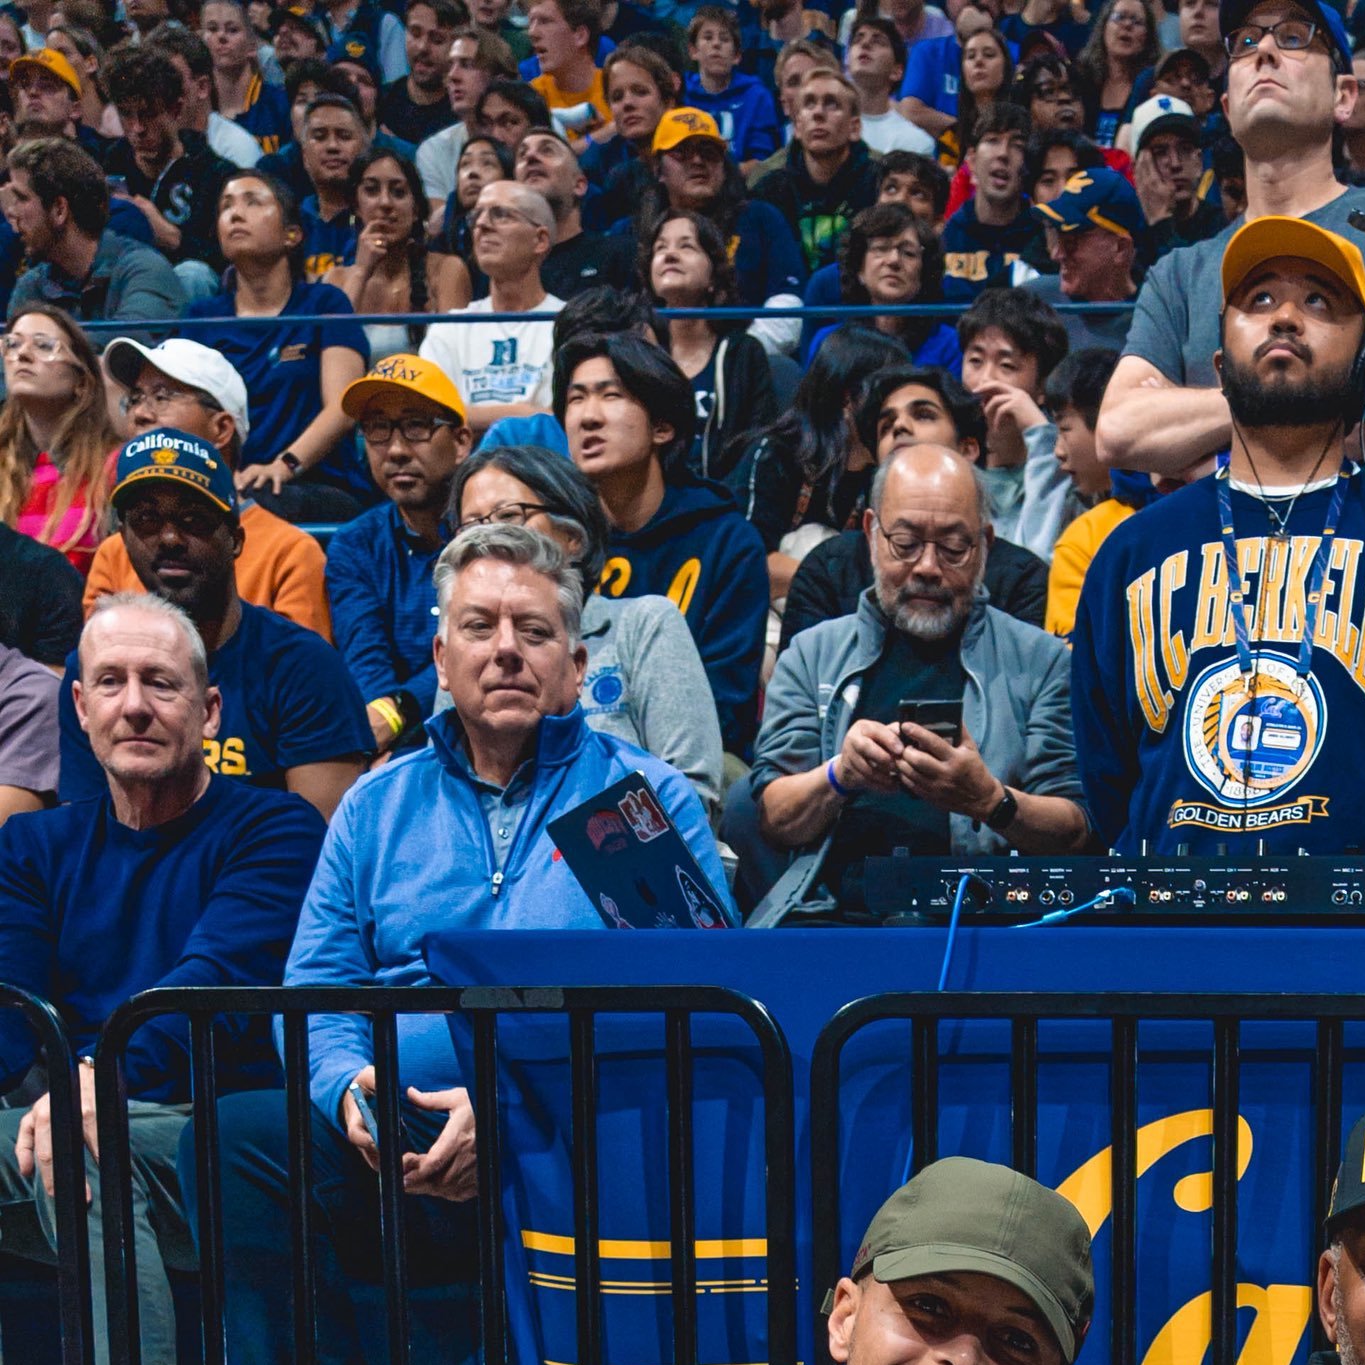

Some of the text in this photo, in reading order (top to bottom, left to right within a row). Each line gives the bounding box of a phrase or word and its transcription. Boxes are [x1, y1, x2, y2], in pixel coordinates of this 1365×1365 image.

[125, 433, 211, 460] California
[1174, 806, 1304, 828] GOLDEN BEARS
